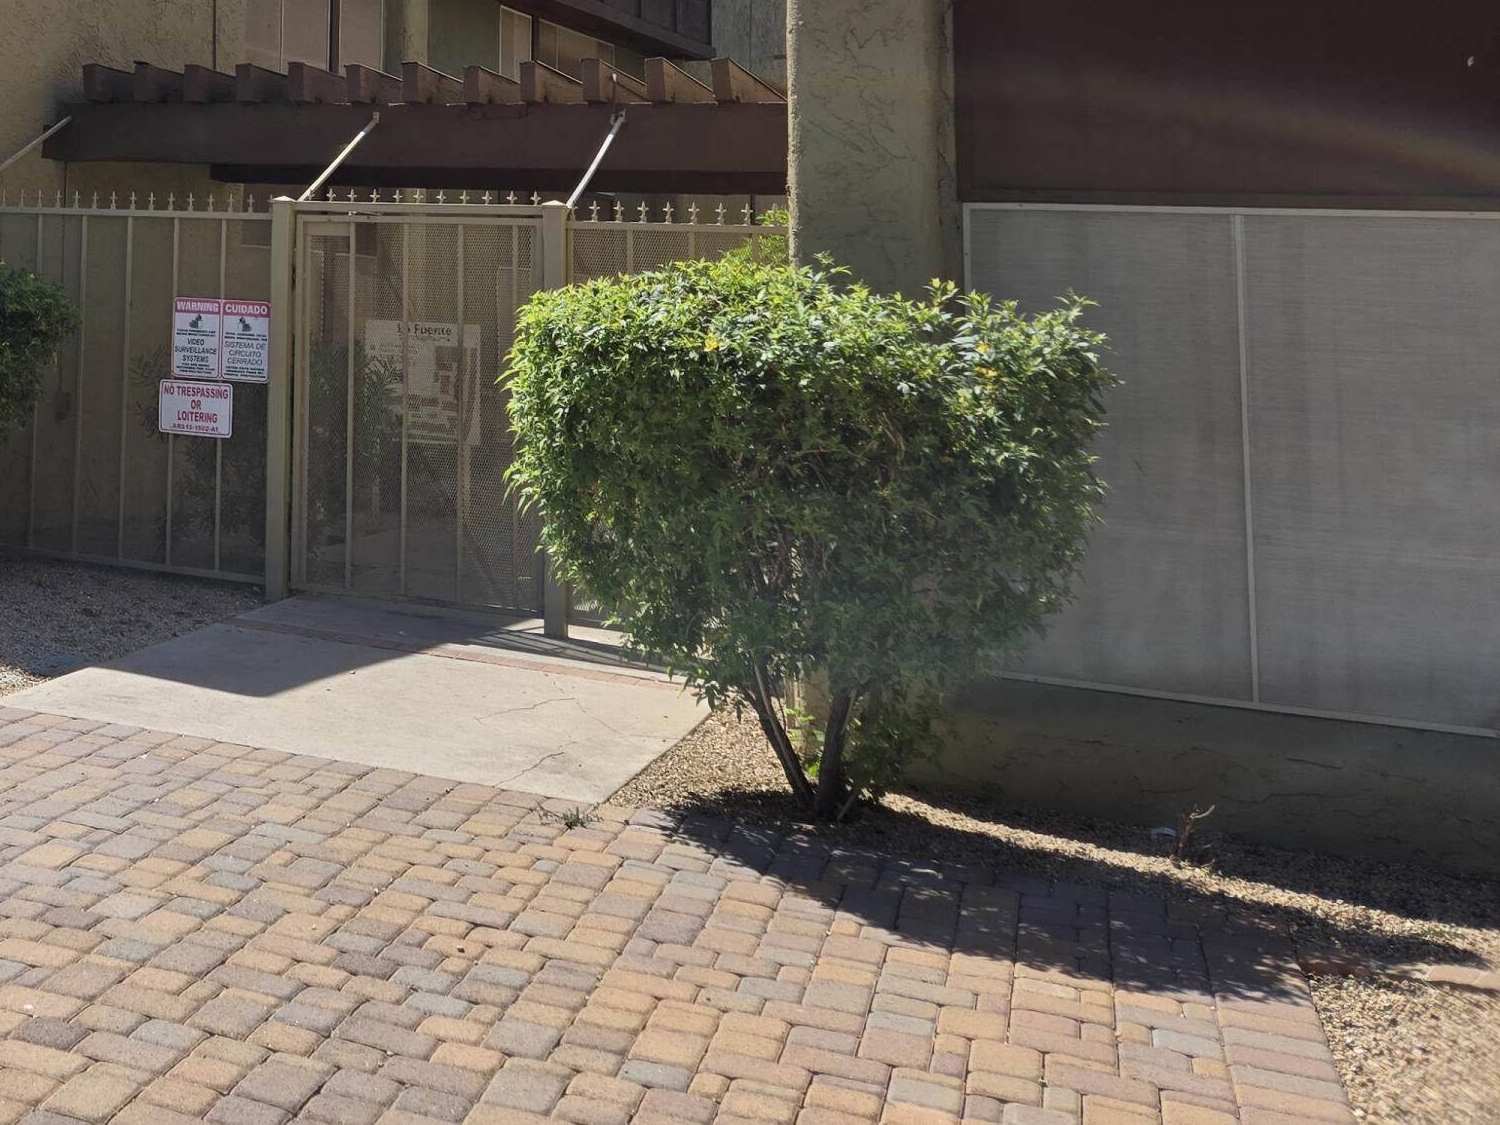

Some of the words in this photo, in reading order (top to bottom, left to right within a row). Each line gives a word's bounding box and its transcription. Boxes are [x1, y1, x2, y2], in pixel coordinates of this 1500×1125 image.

[177, 301, 219, 312] WARNING
[225, 303, 268, 315] CUIDADO
[414, 324, 452, 336] Fuente
[187, 338, 205, 346] VIDEO
[224, 341, 254, 349] SISTEMA
[255, 342, 267, 350] DE
[174, 346, 217, 355] SURVEILLANCE
[228, 349, 262, 358] CIRCUITO
[182, 355, 209, 363] SYSTEMS
[227, 358, 263, 366] CERRADO
[164, 385, 175, 395] NO
[177, 386, 228, 399] TRESPASSING
[190, 399, 202, 410] OR
[177, 410, 218, 423] LOITERING
